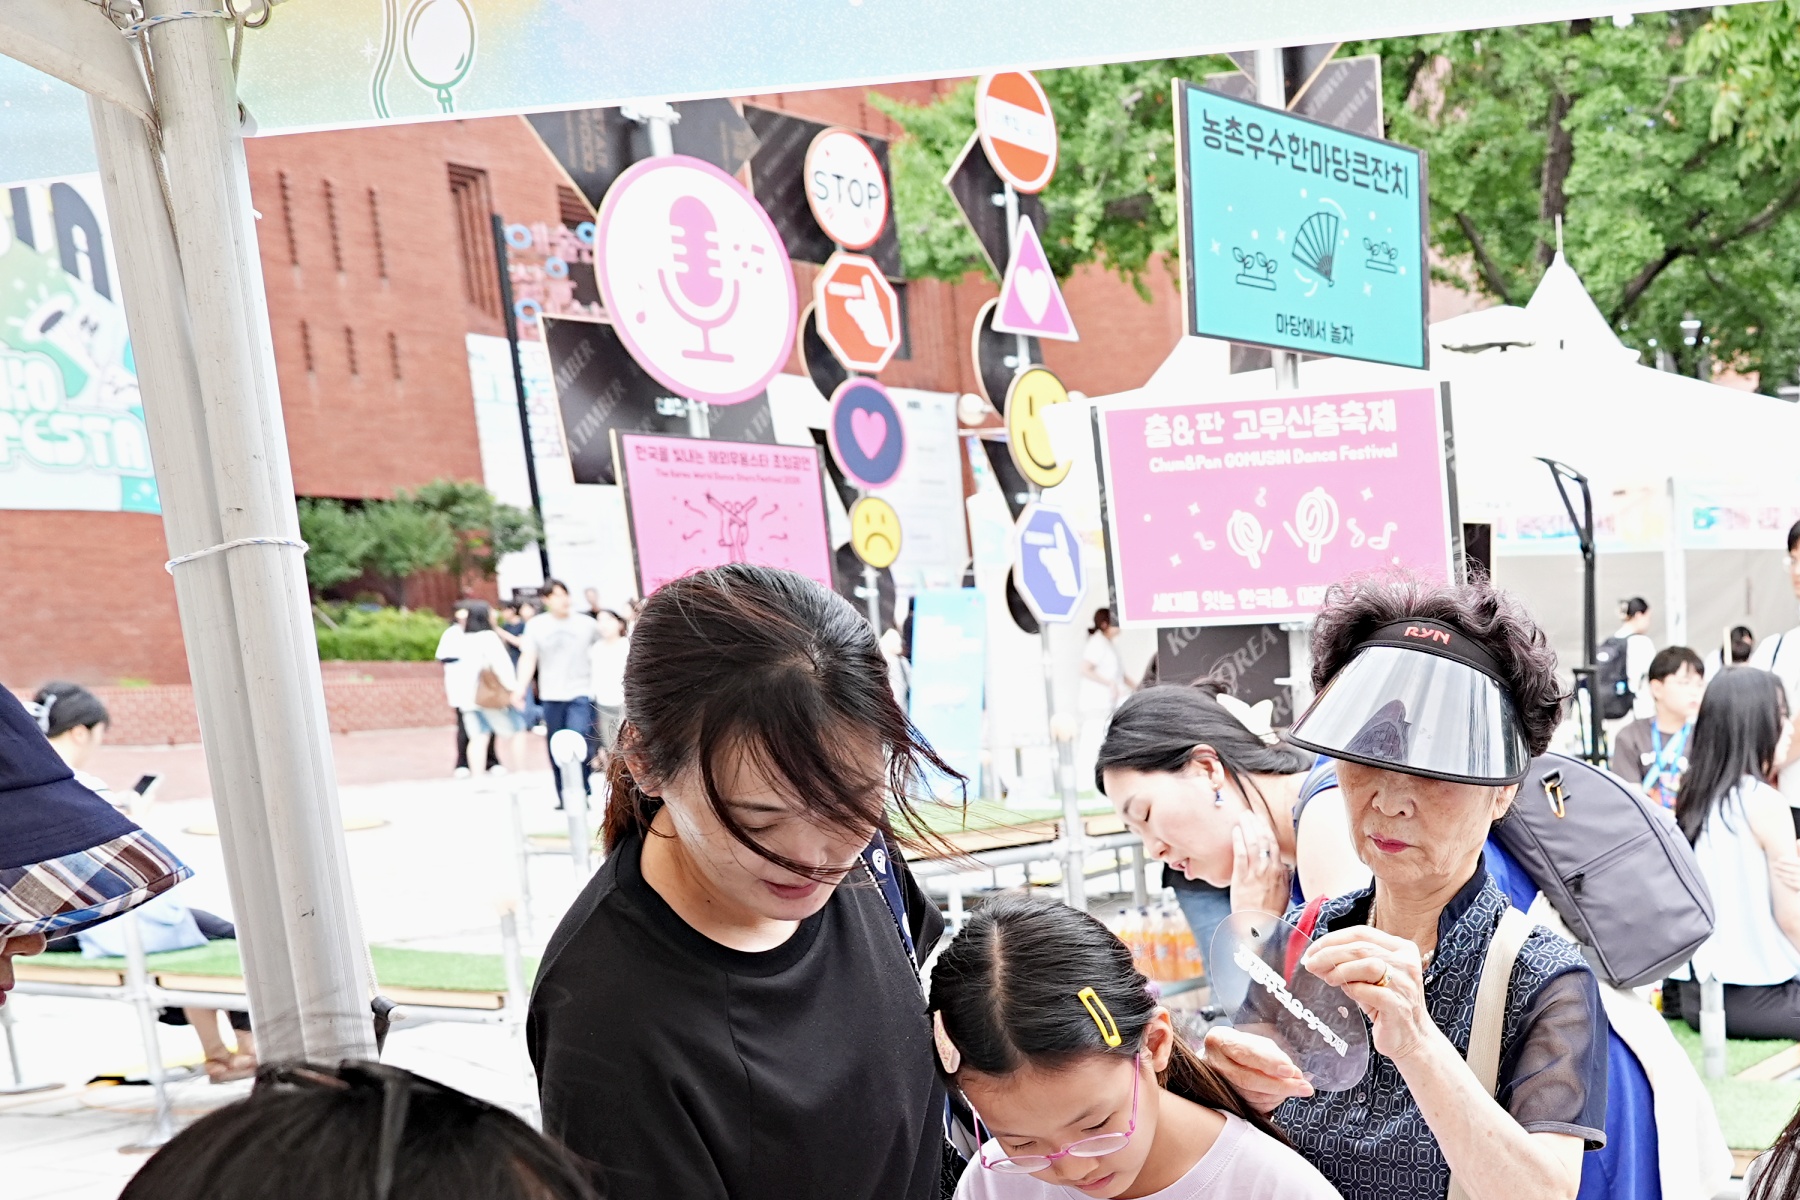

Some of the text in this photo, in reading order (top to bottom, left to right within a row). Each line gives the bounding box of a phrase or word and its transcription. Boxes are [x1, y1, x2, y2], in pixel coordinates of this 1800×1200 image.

[1202, 108, 1409, 199] 농촌우수한마당큰잔치
[814, 170, 882, 209] STOP
[1276, 313, 1354, 345] 마당에서 놀자
[1144, 399, 1397, 449] 춤&판 고무신춤축제
[1149, 443, 1398, 473] Chum&Pan GOMUSIN Dance Festival
[1403, 625, 1451, 646] RYN
